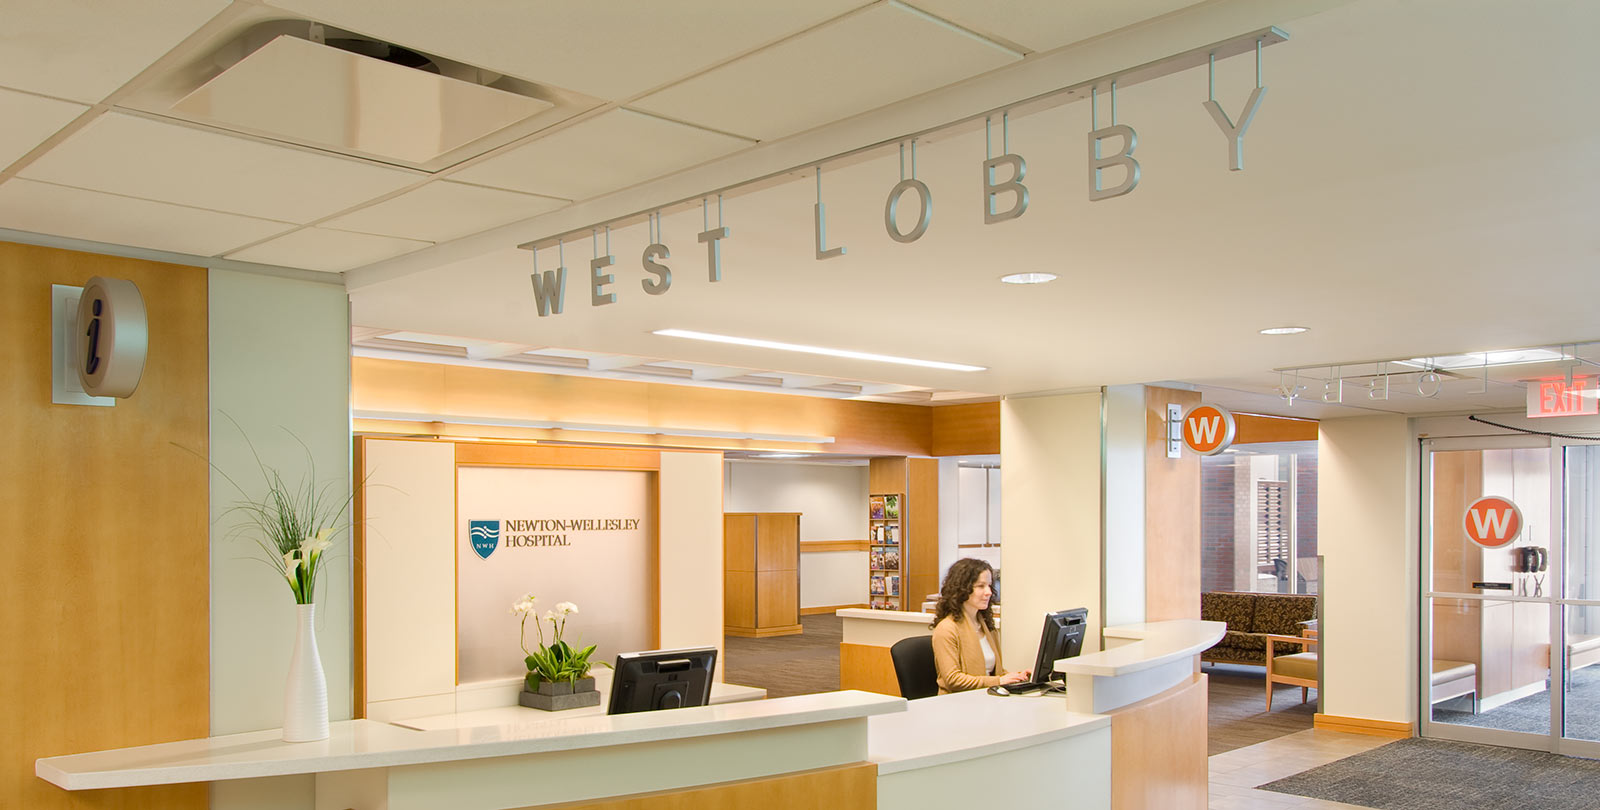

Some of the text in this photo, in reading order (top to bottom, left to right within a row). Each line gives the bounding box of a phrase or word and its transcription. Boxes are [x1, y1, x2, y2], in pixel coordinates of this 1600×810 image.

[531, 85, 1268, 317] WEST LOBBY
[1540, 381, 1586, 414] EXIT
[1188, 416, 1221, 445] W
[505, 519, 641, 532] NEWTON-WELLESLEY
[1470, 508, 1513, 539] W
[505, 535, 571, 548] HOSPITAL
